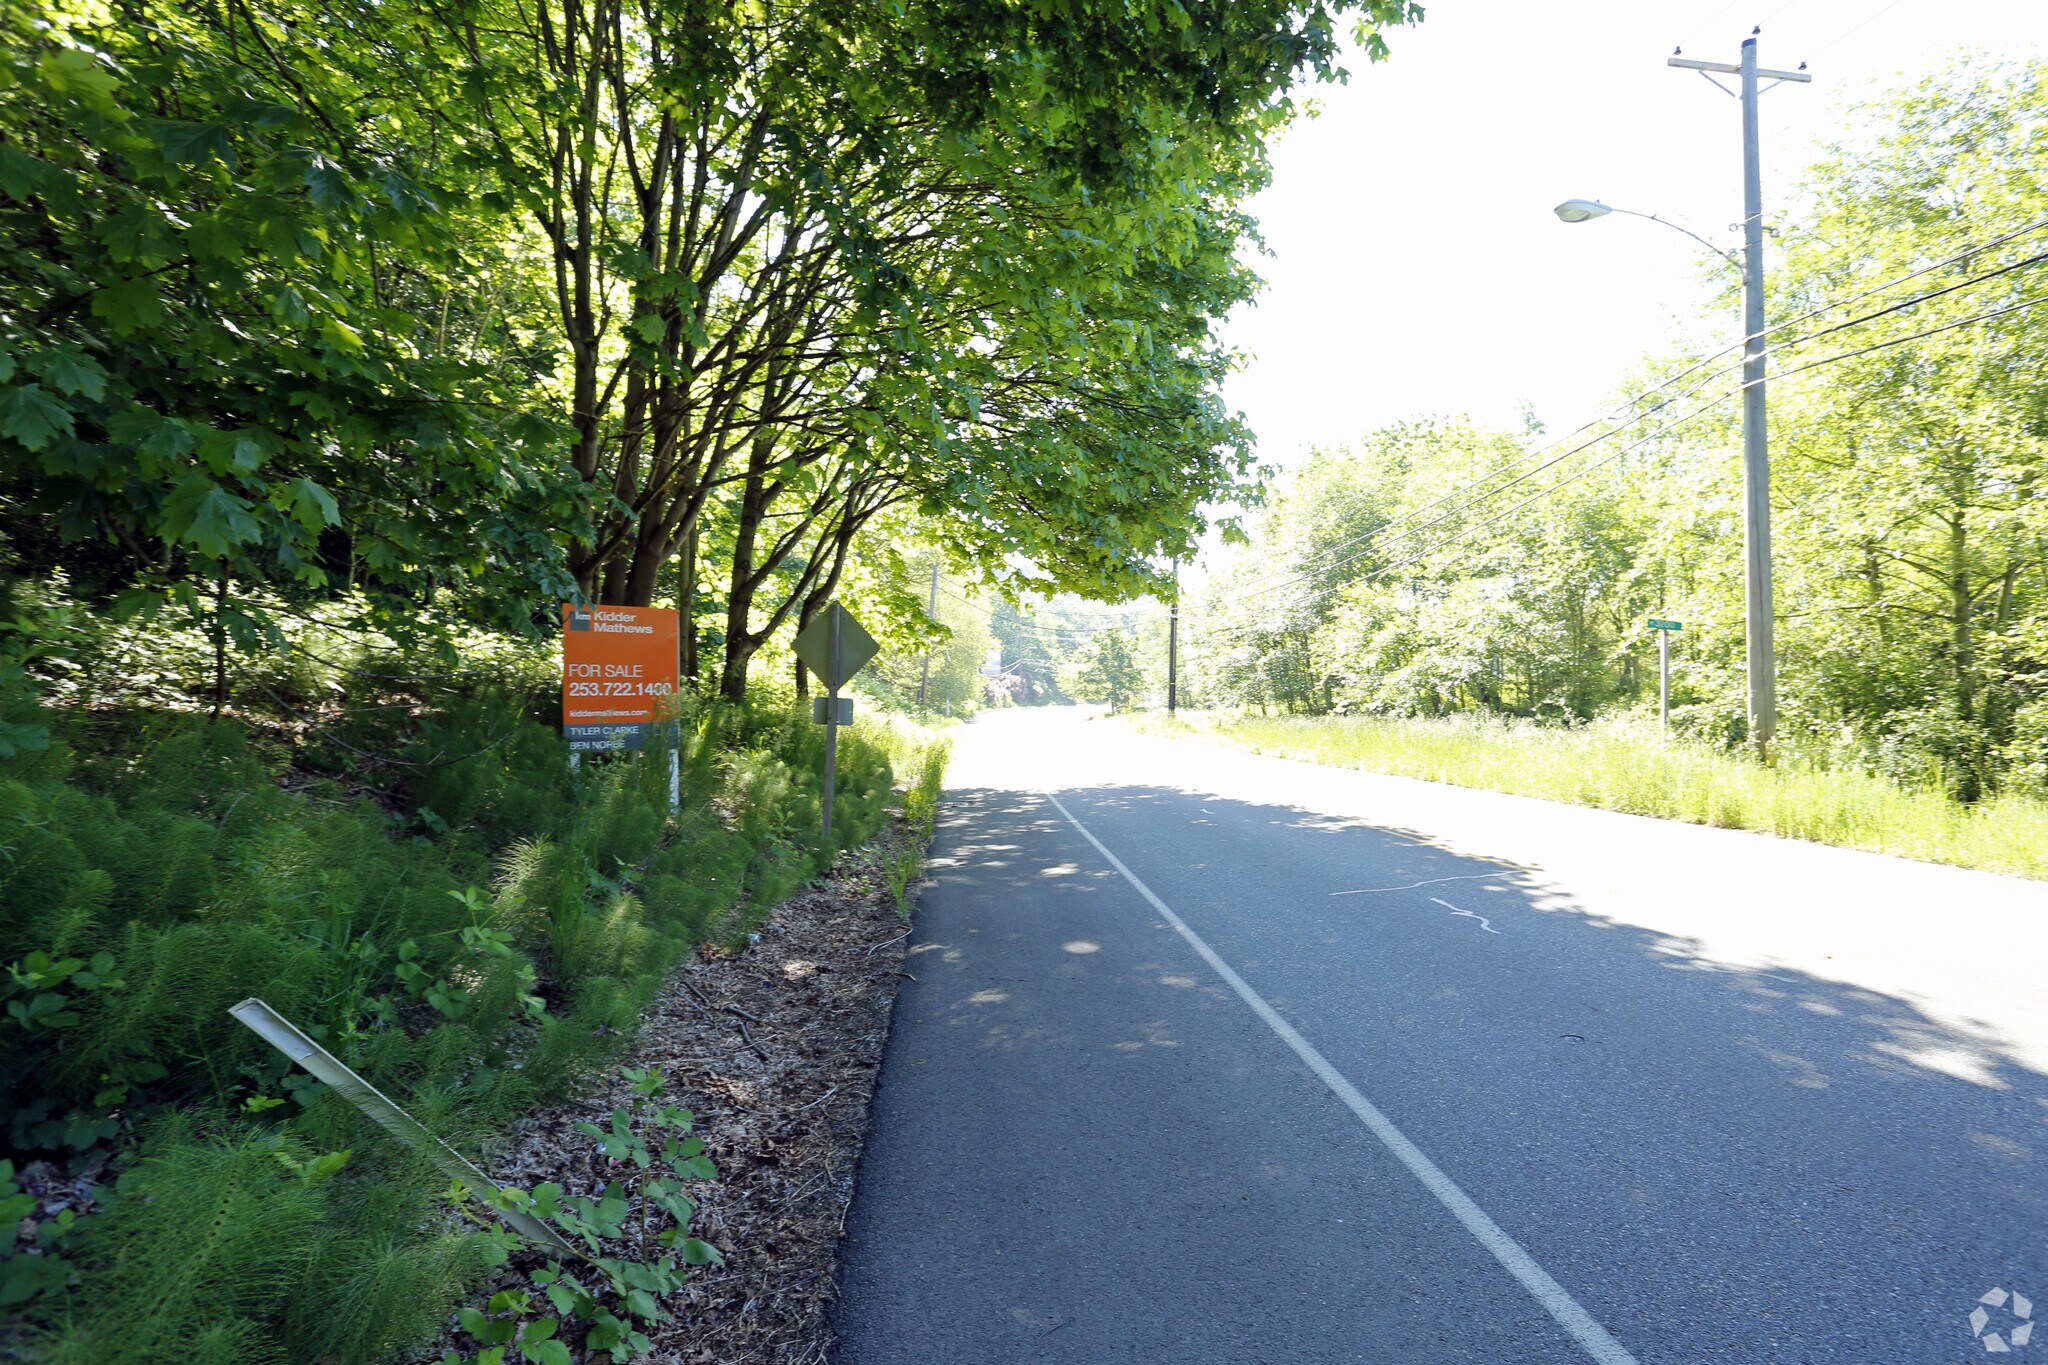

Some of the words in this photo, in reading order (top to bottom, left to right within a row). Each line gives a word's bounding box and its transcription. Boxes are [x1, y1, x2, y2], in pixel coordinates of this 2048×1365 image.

[594, 611, 636, 622] Kidder
[594, 623, 653, 634] Mathews
[568, 664, 601, 677] FOR
[604, 665, 643, 677] SALE
[570, 727, 600, 735] TYLER
[602, 726, 639, 735] CLARKE
[570, 741, 590, 749] BEN
